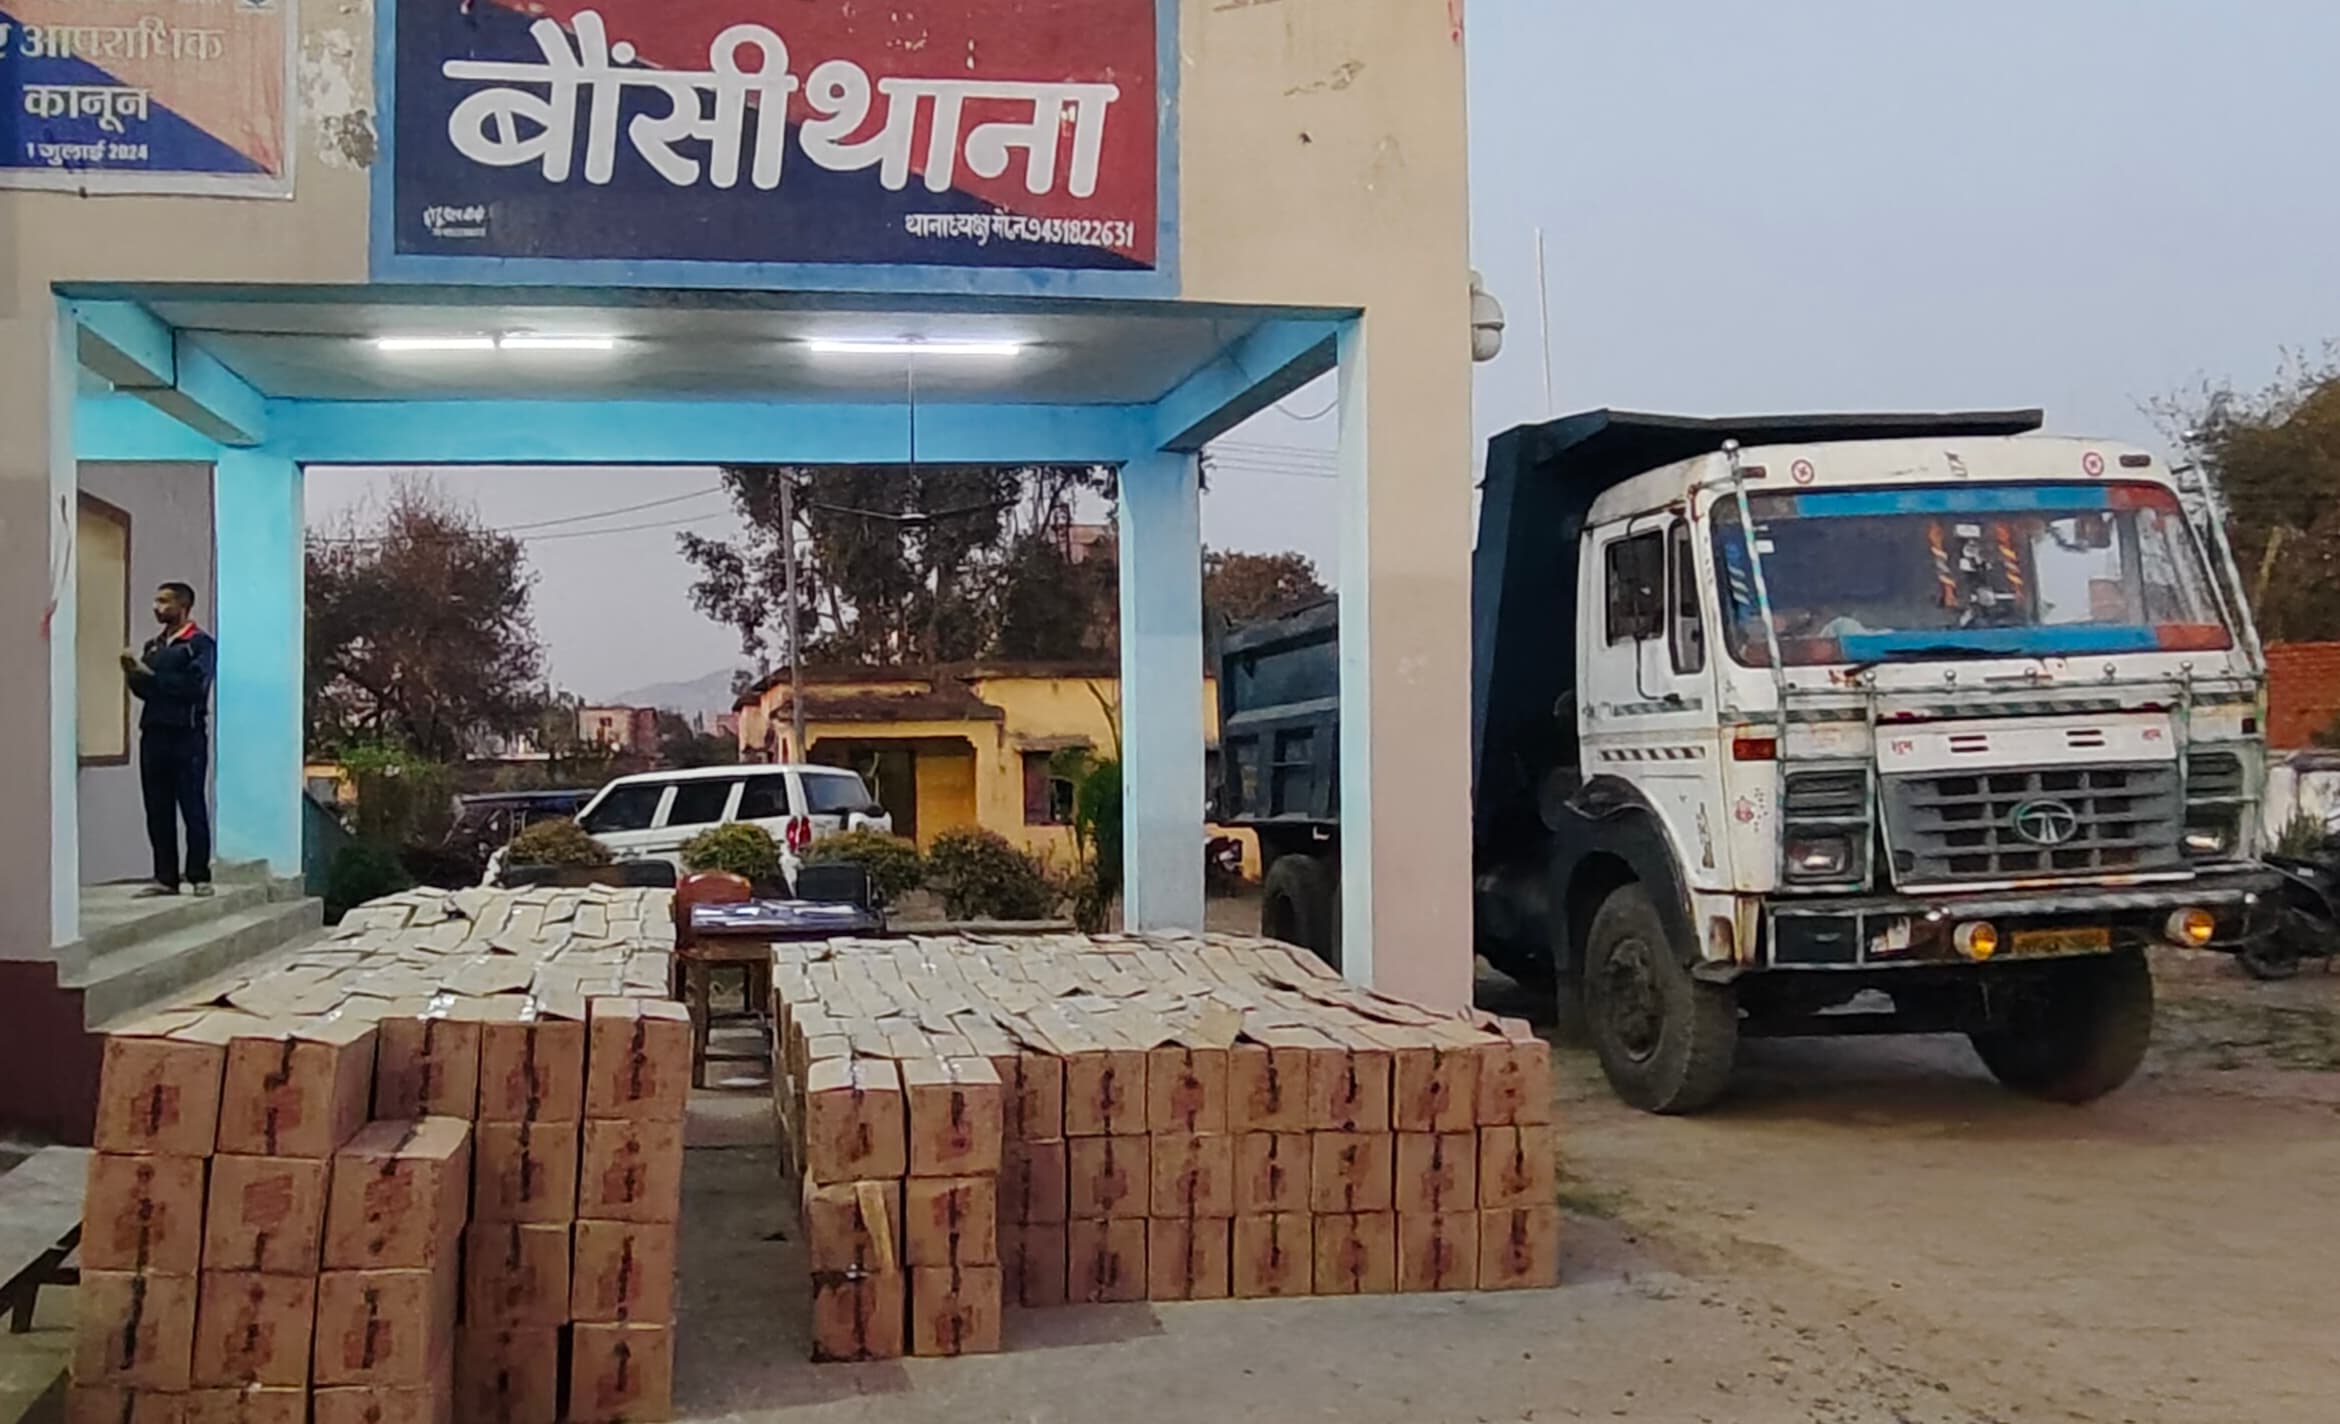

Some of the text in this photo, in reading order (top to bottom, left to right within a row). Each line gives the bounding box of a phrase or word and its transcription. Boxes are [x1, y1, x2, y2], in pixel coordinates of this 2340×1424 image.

[20, 16, 225, 59] आपराधिक
[23, 85, 150, 134] कानून
[799, 60, 1120, 198] थाना
[38, 139, 107, 166] जुलाई
[108, 144, 148, 160] 2024
